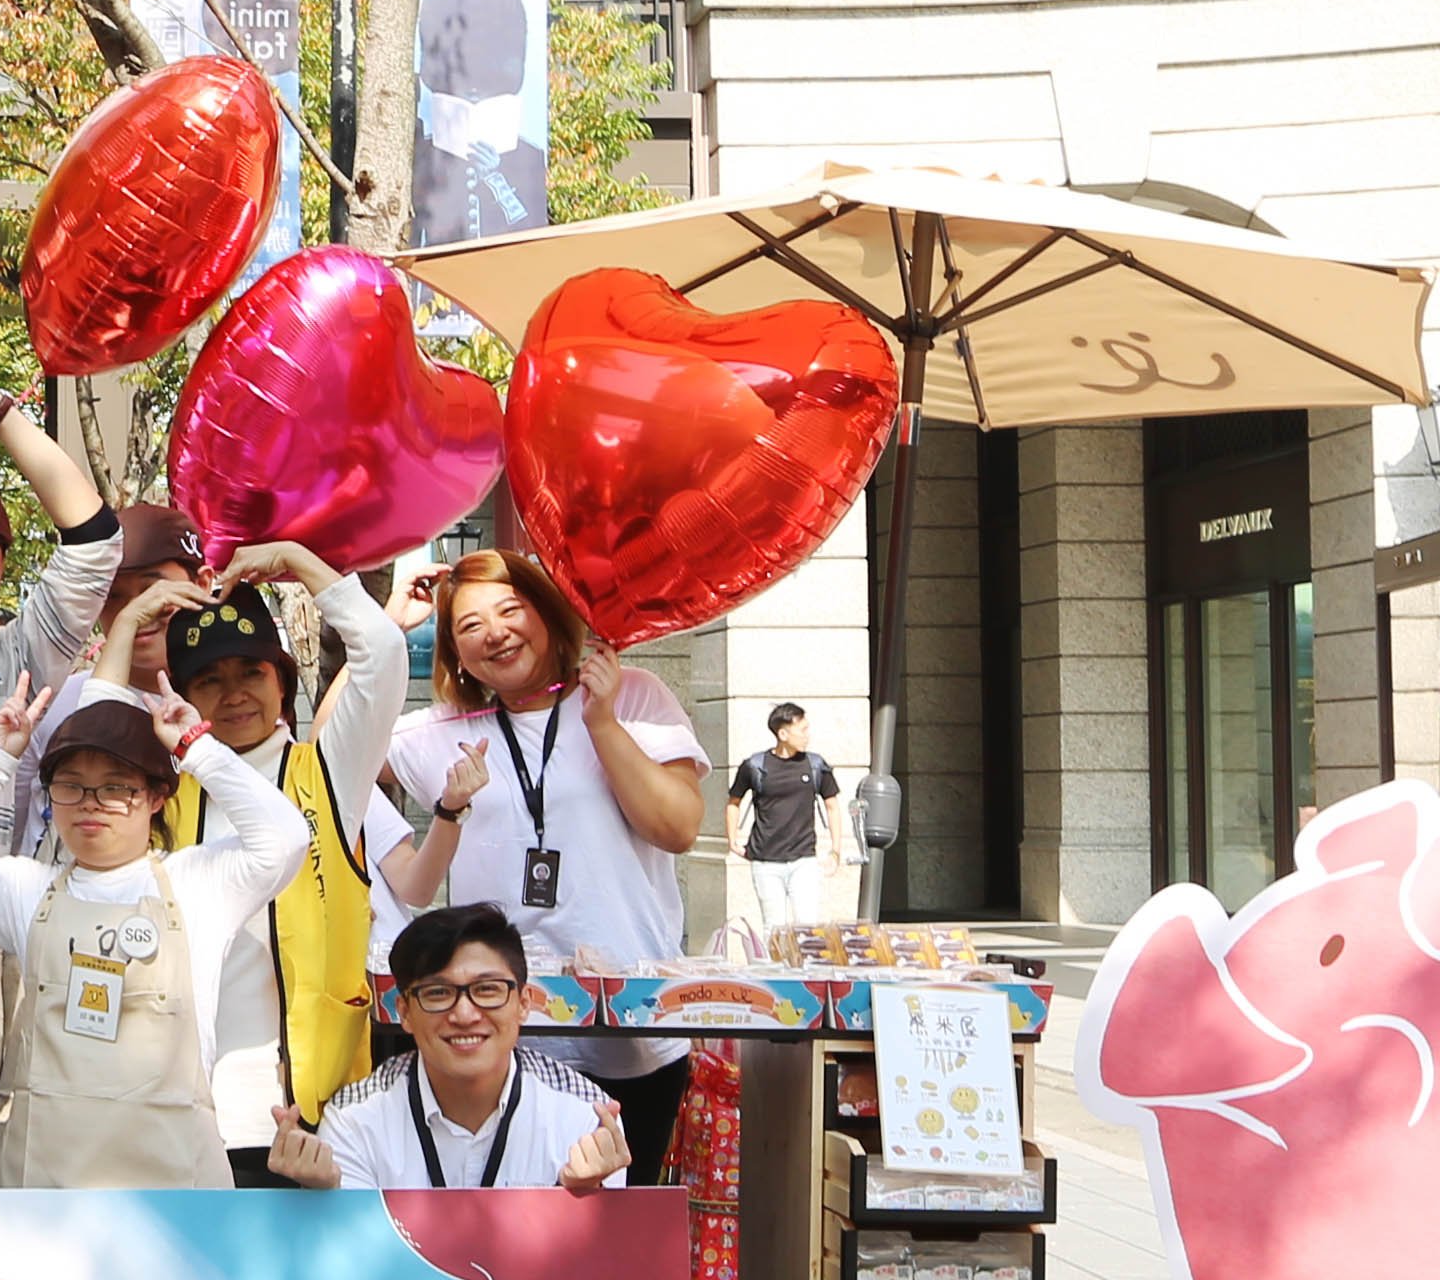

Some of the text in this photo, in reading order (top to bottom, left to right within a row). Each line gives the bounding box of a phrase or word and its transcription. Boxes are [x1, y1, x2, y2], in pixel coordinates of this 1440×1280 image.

[1199, 508, 1273, 543] DELVAUX
[124, 927, 152, 943] SGS
[679, 983, 713, 1004] modo
